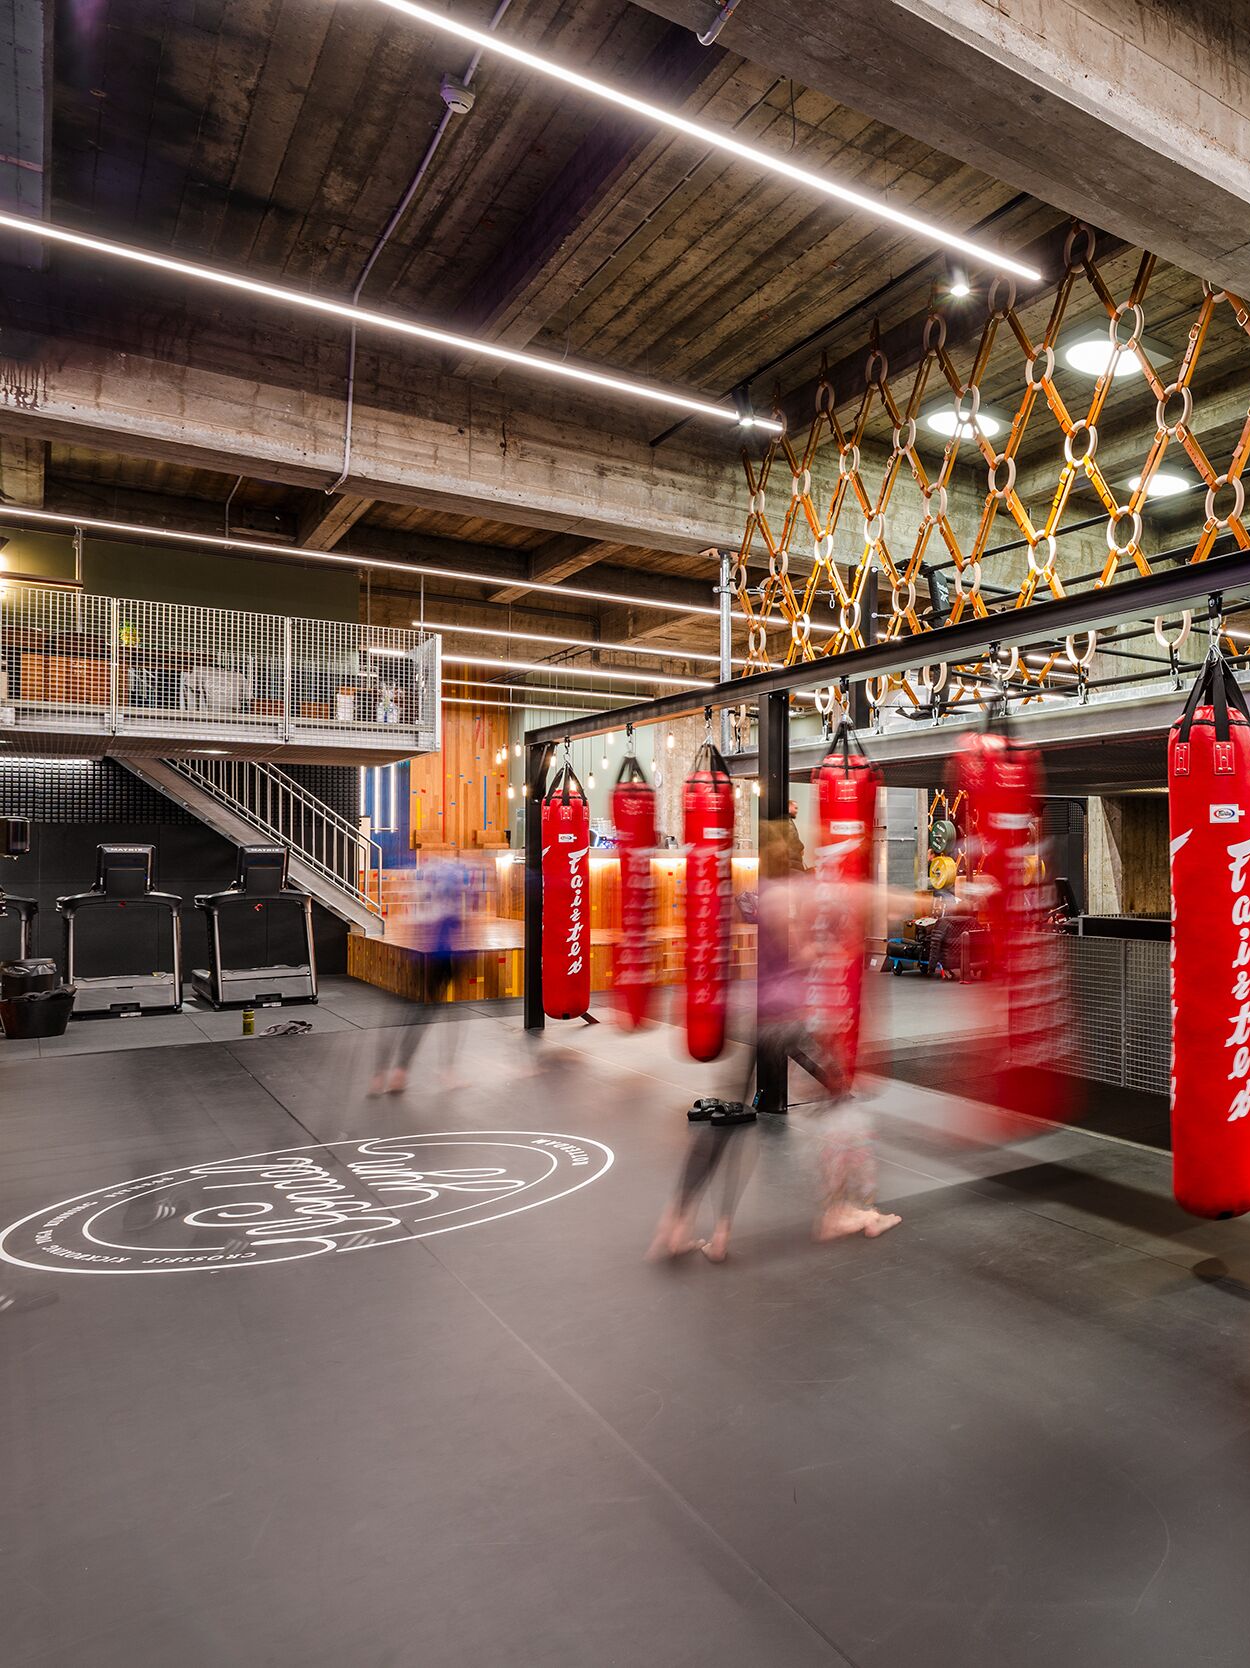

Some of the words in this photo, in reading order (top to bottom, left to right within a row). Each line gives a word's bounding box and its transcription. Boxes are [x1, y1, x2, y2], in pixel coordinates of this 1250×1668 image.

[566, 846, 590, 976] Fairtex
[530, 1138, 590, 1167] ROTTERDAM
[142, 1251, 257, 1265] CROSSFIT
